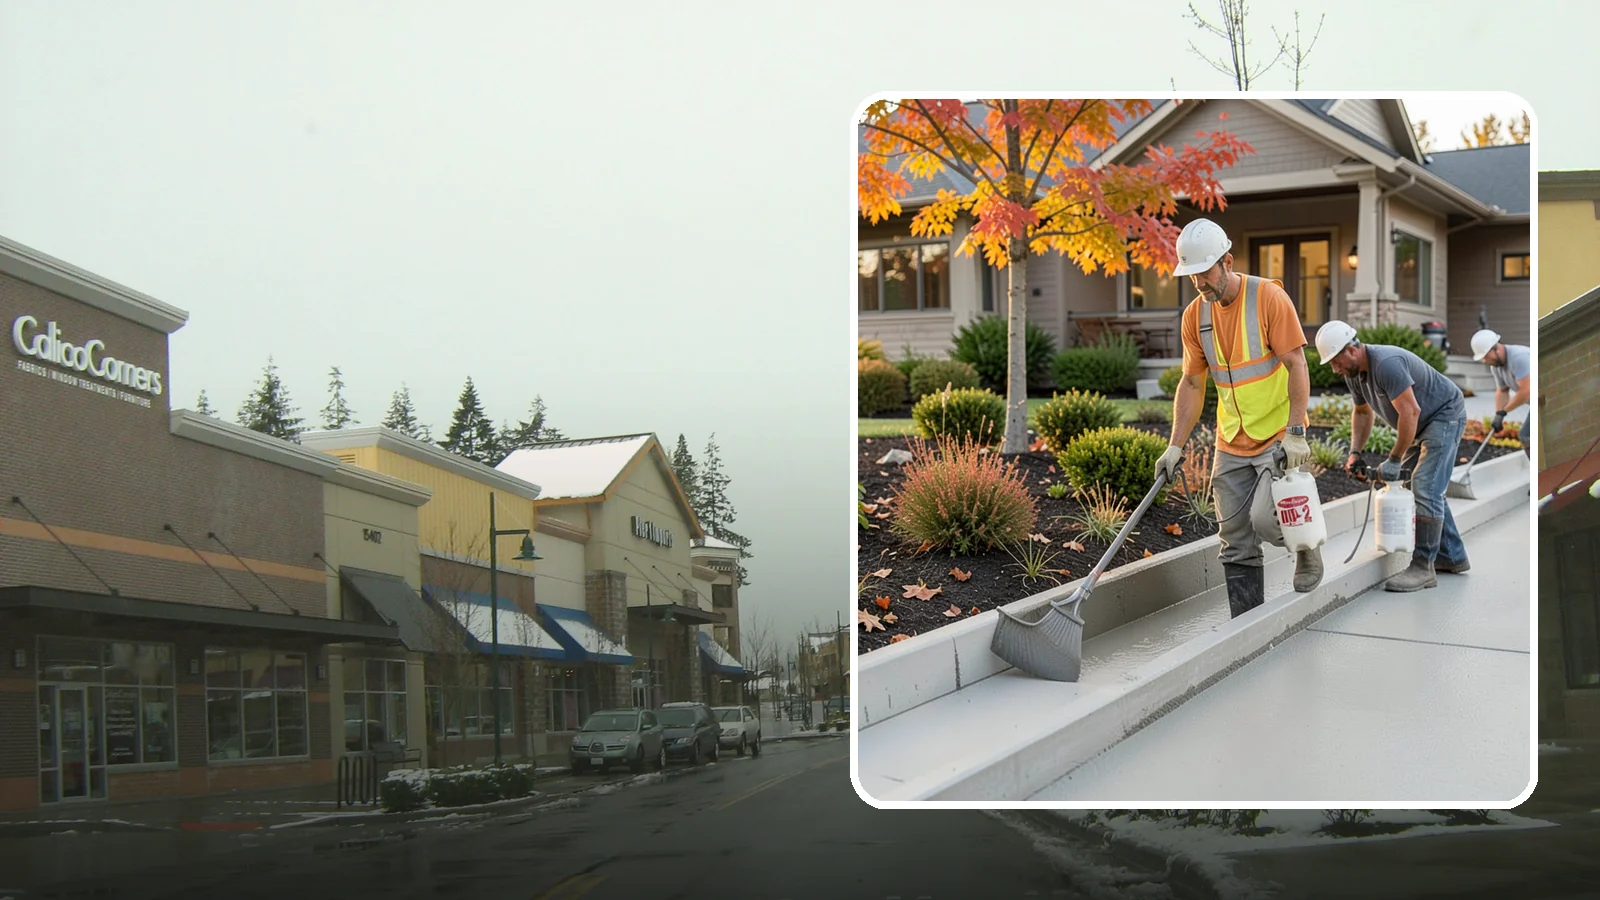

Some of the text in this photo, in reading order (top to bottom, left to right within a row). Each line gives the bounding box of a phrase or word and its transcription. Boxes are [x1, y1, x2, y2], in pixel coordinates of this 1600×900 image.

[17, 360, 151, 408] FABRICS WINDOW TREATMENTS FURNITURE
